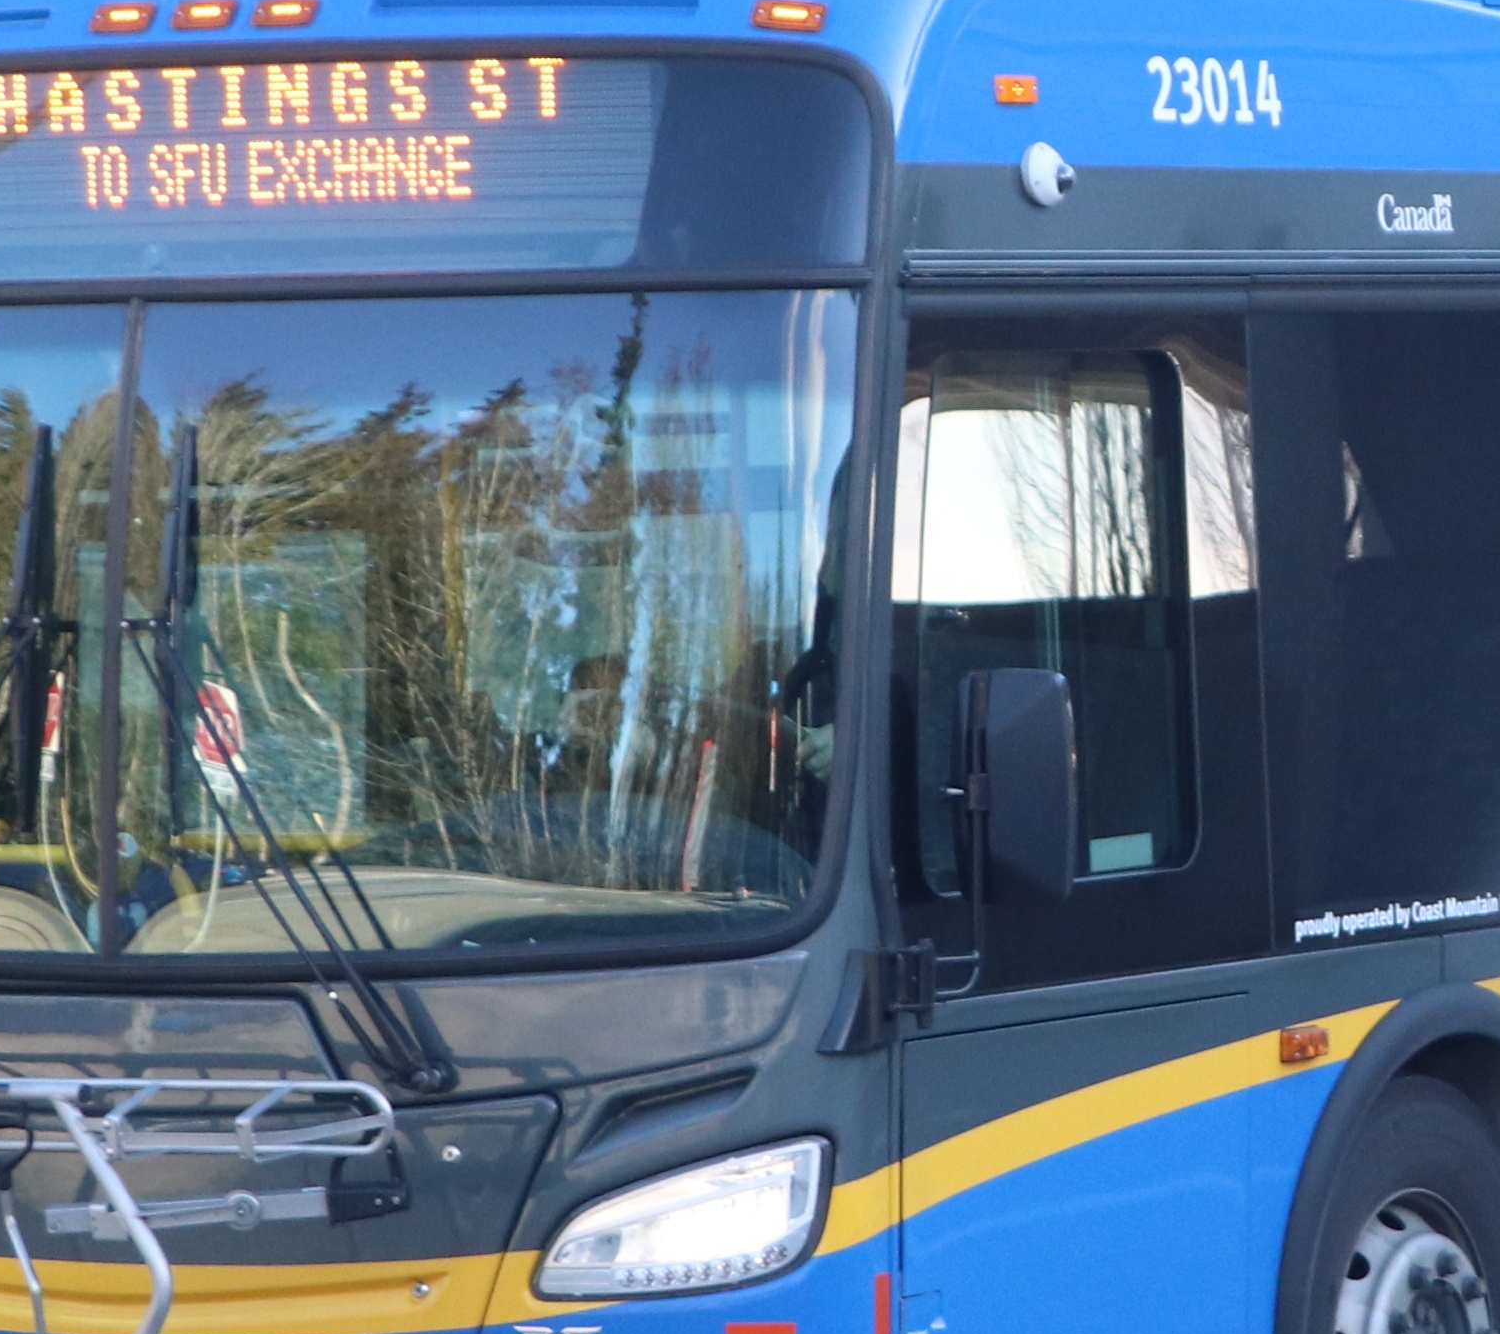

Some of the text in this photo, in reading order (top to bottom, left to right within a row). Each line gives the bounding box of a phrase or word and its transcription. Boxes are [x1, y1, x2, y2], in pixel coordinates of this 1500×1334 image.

[468, 56, 564, 120] ST
[1146, 55, 1283, 127] 23014
[81, 135, 472, 209] TO SFU EXCHANGE
[1377, 192, 1454, 233] Canada
[1294, 911, 1340, 943] proudly
[1342, 903, 1394, 935] operated
[1395, 902, 1410, 929] by
[1412, 901, 1445, 923] Coast
[1446, 892, 1499, 918] Mountain
